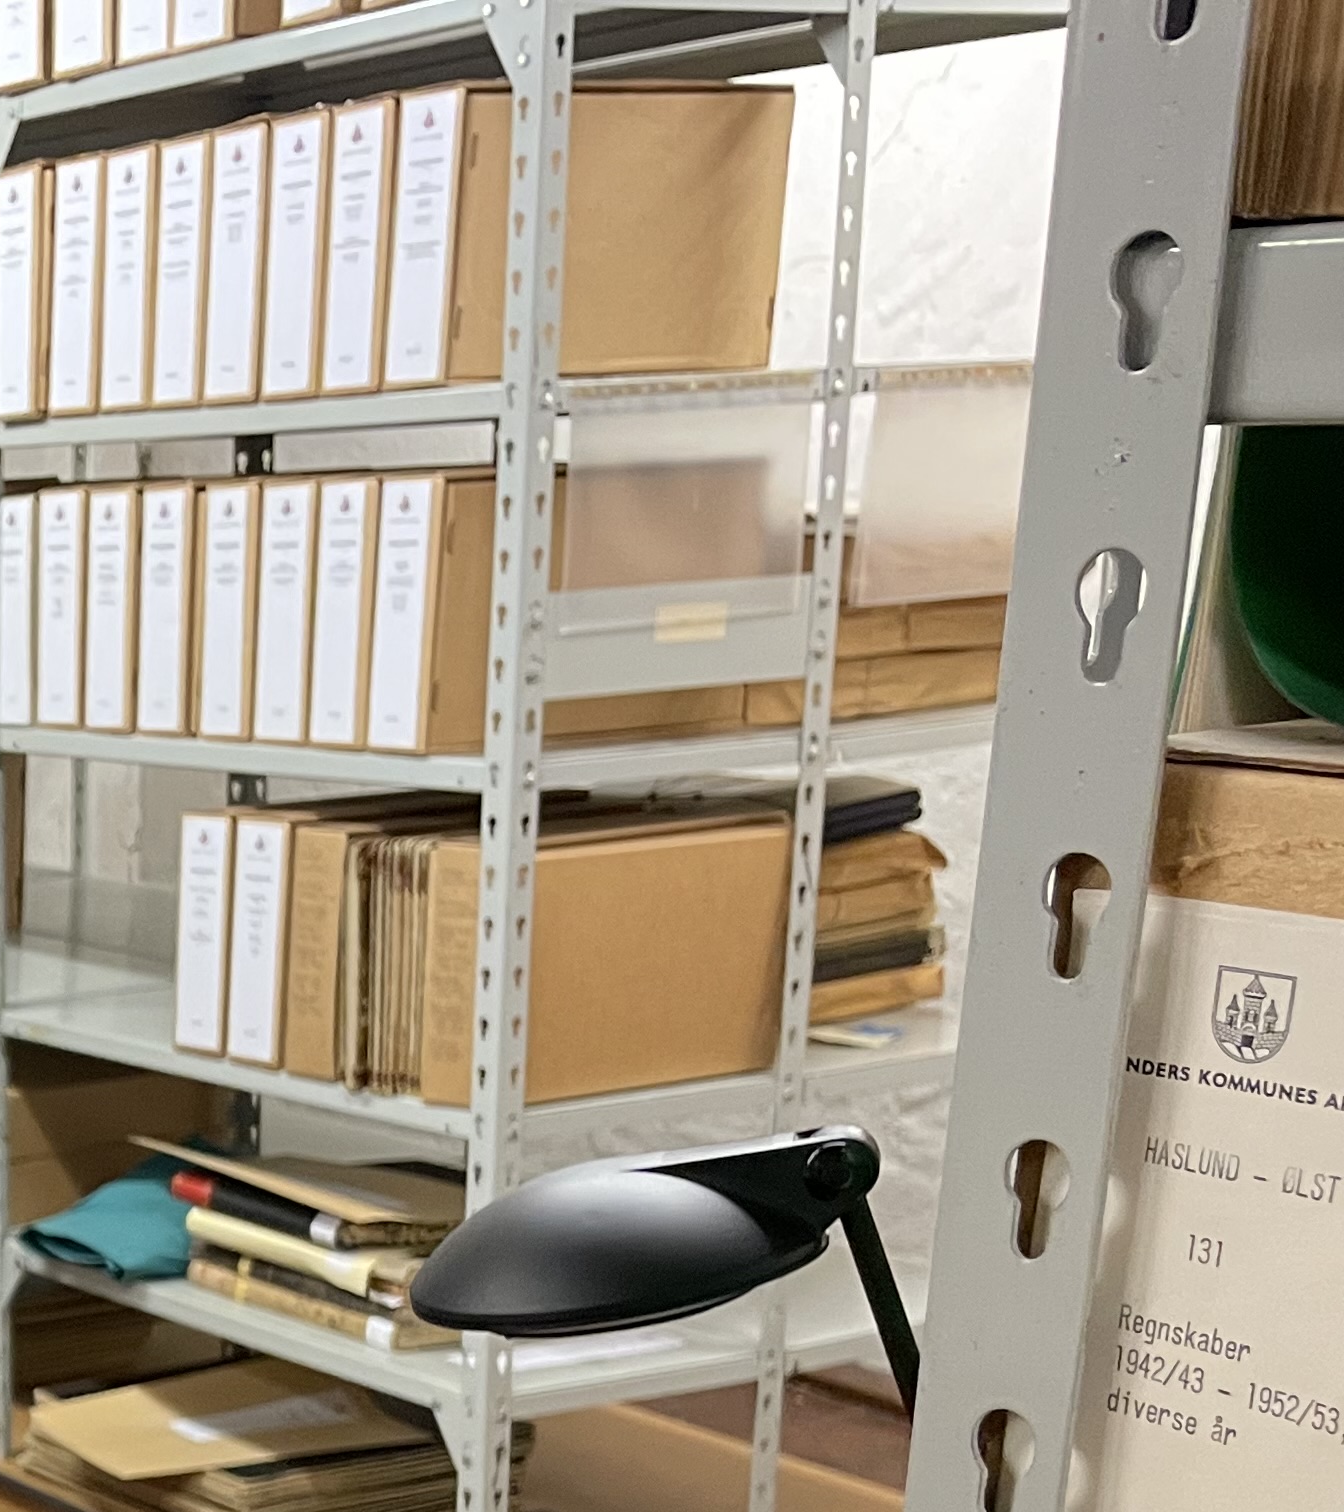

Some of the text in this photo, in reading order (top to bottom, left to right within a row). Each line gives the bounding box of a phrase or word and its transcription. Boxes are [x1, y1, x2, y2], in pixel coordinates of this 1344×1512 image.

[1198, 1069, 1318, 1105] KOMMUNES
[1144, 1136, 1241, 1181] HASLUND
[1281, 1166, 1342, 1204] ØLST
[1188, 1233, 1223, 1268] 131
[1118, 1303, 1251, 1362] Regnskaber
[1116, 1345, 1205, 1394] 1942/43
[1107, 1386, 1237, 1446] diverse år
